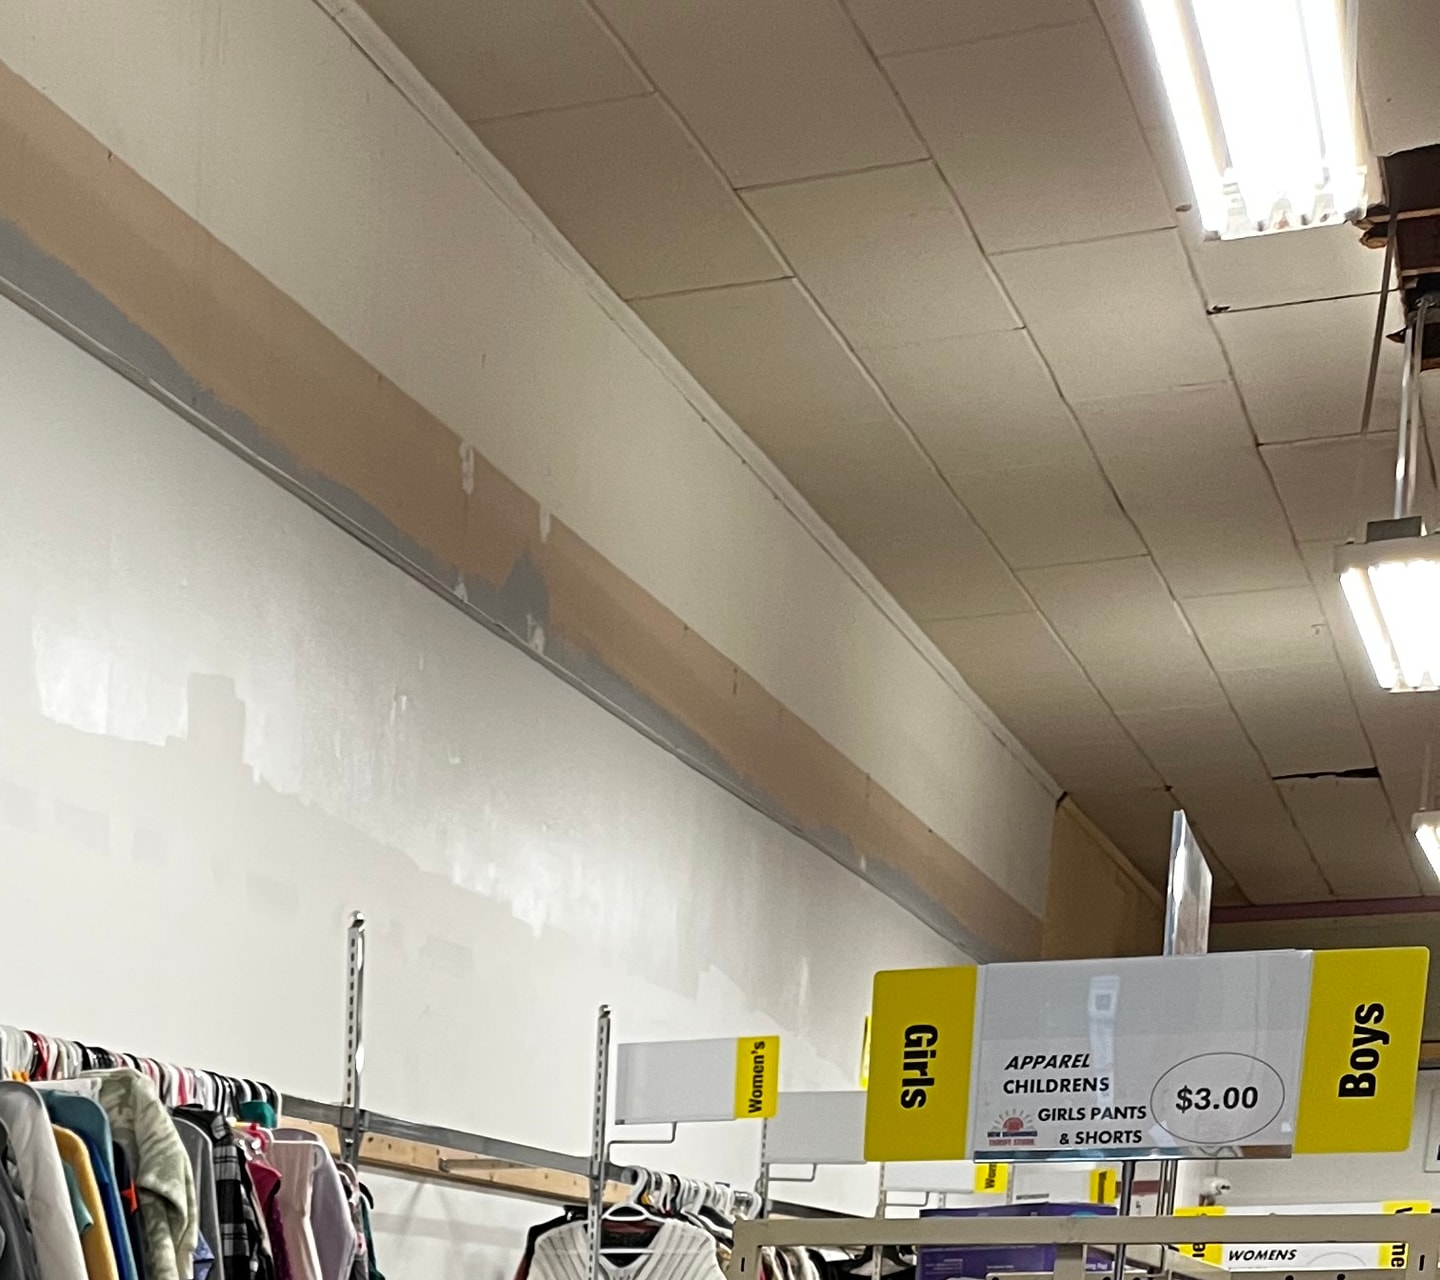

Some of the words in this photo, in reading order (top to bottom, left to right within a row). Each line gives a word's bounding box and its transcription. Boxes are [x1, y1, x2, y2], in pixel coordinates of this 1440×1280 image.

[1337, 1002, 1389, 1100] Boys
[899, 1023, 939, 1110] Girls
[1003, 1053, 1092, 1071] APPAREL
[747, 1040, 766, 1115] Women's
[1002, 1076, 1111, 1096] CHILDRENS
[1175, 1085, 1259, 1113] $3.00
[1037, 1105, 1087, 1123] GIRLS
[1090, 1105, 1148, 1121] PANTS
[1059, 1131, 1070, 1146] &
[1074, 1129, 1143, 1145] SHORTS
[1228, 1249, 1297, 1261] WOMENS
